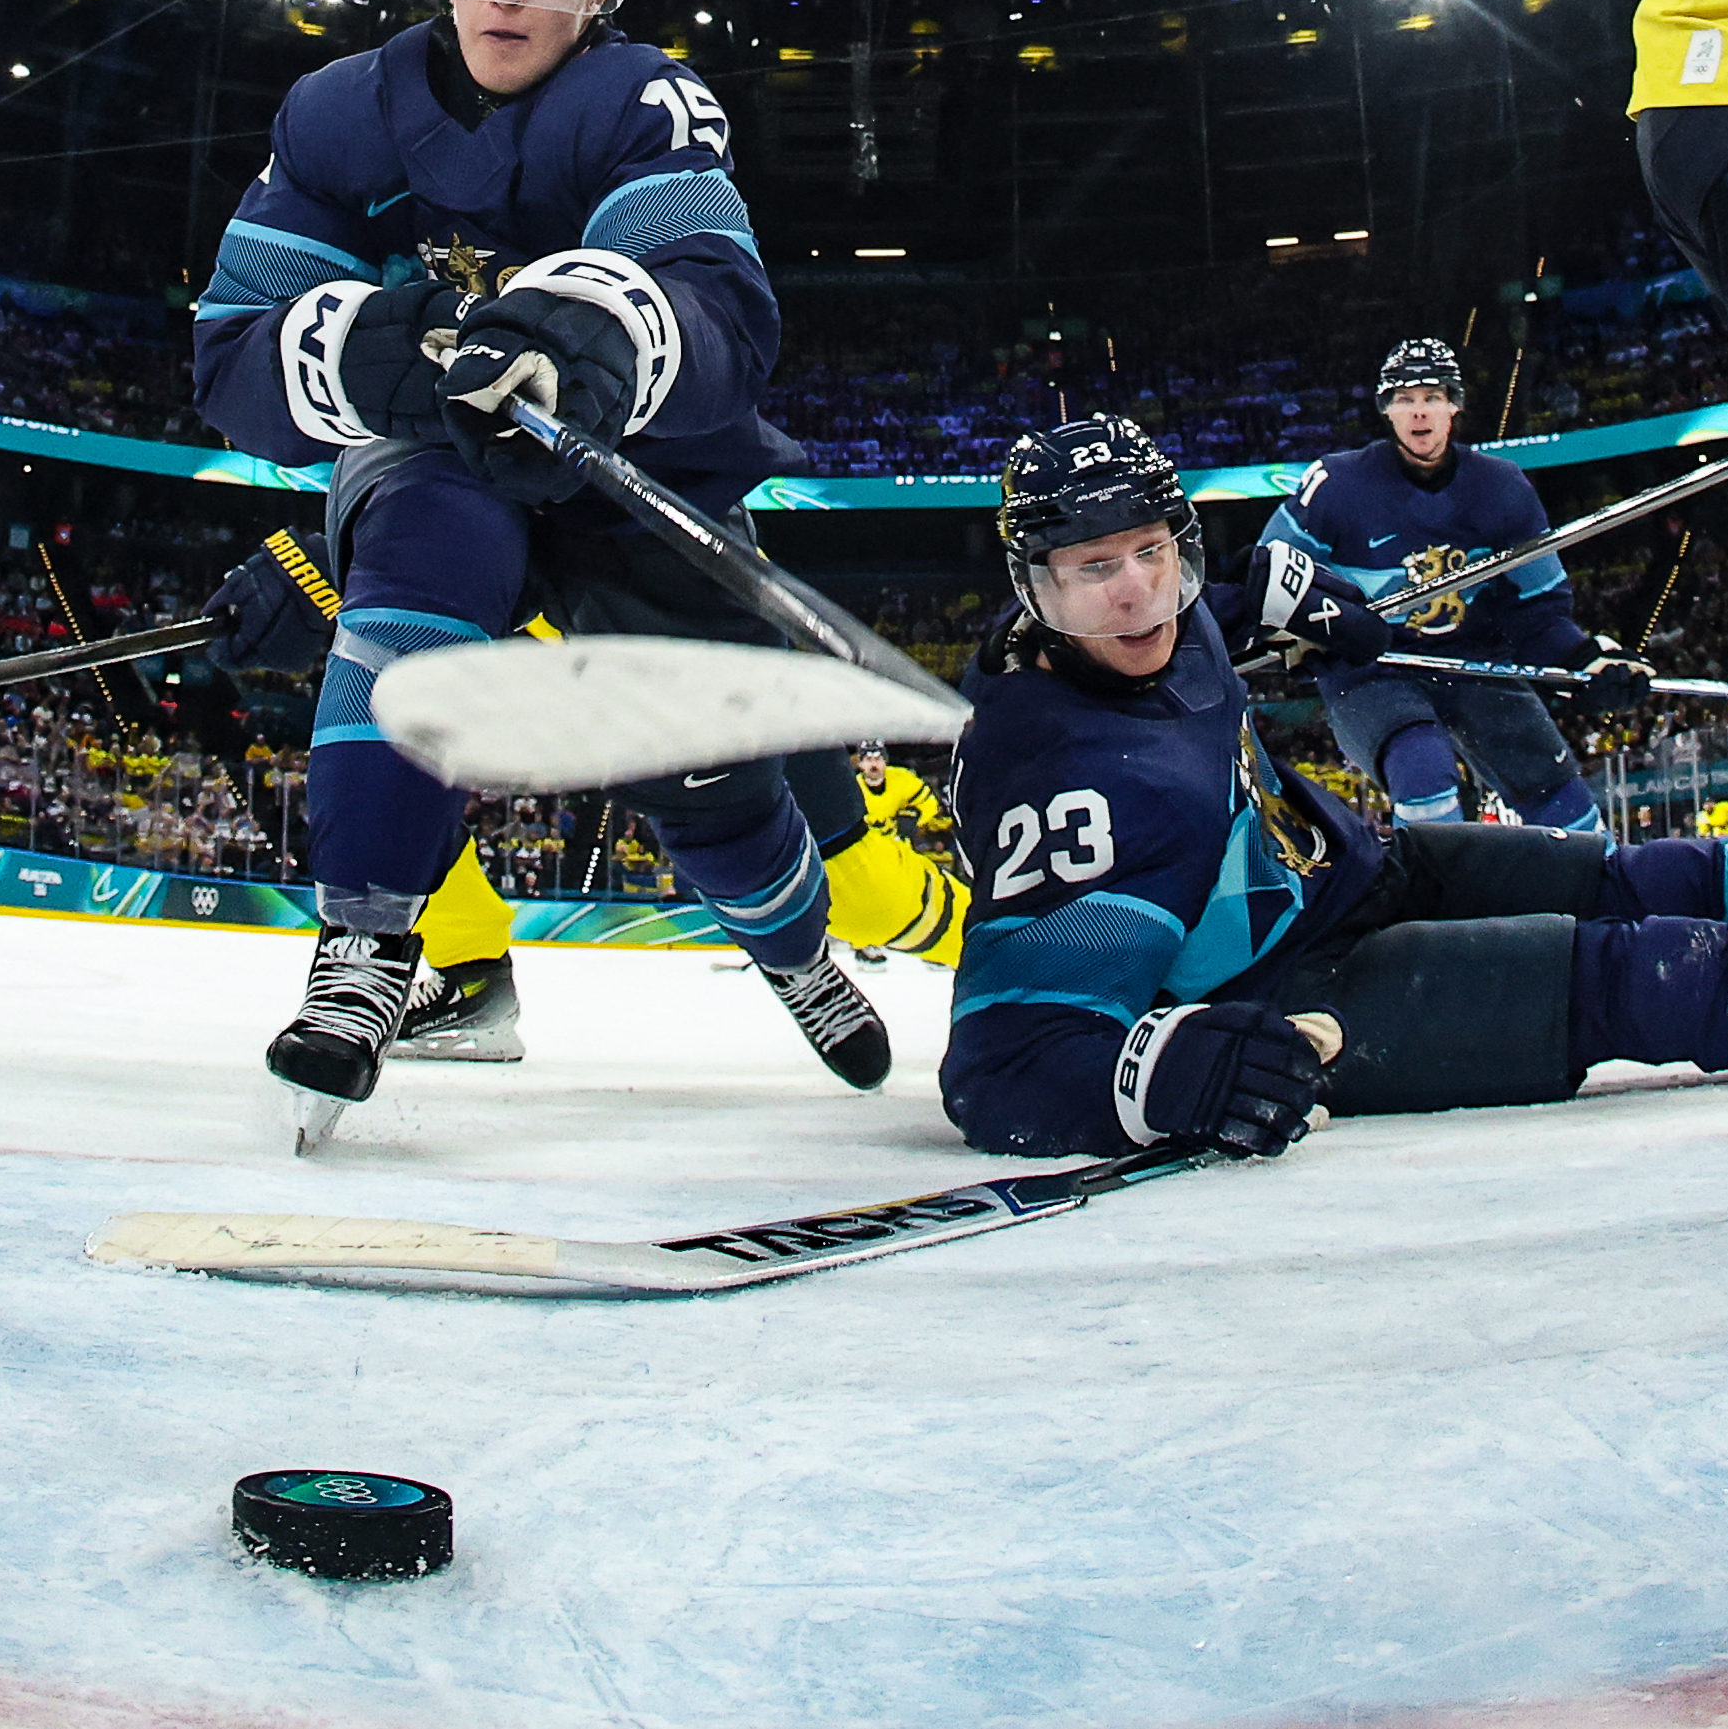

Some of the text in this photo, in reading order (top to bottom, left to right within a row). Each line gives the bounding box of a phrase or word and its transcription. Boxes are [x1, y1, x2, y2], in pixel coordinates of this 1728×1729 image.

[639, 77, 729, 159] 15
[546, 261, 667, 419] CCM
[1069, 441, 1113, 472] 23
[992, 787, 1115, 901] 23
